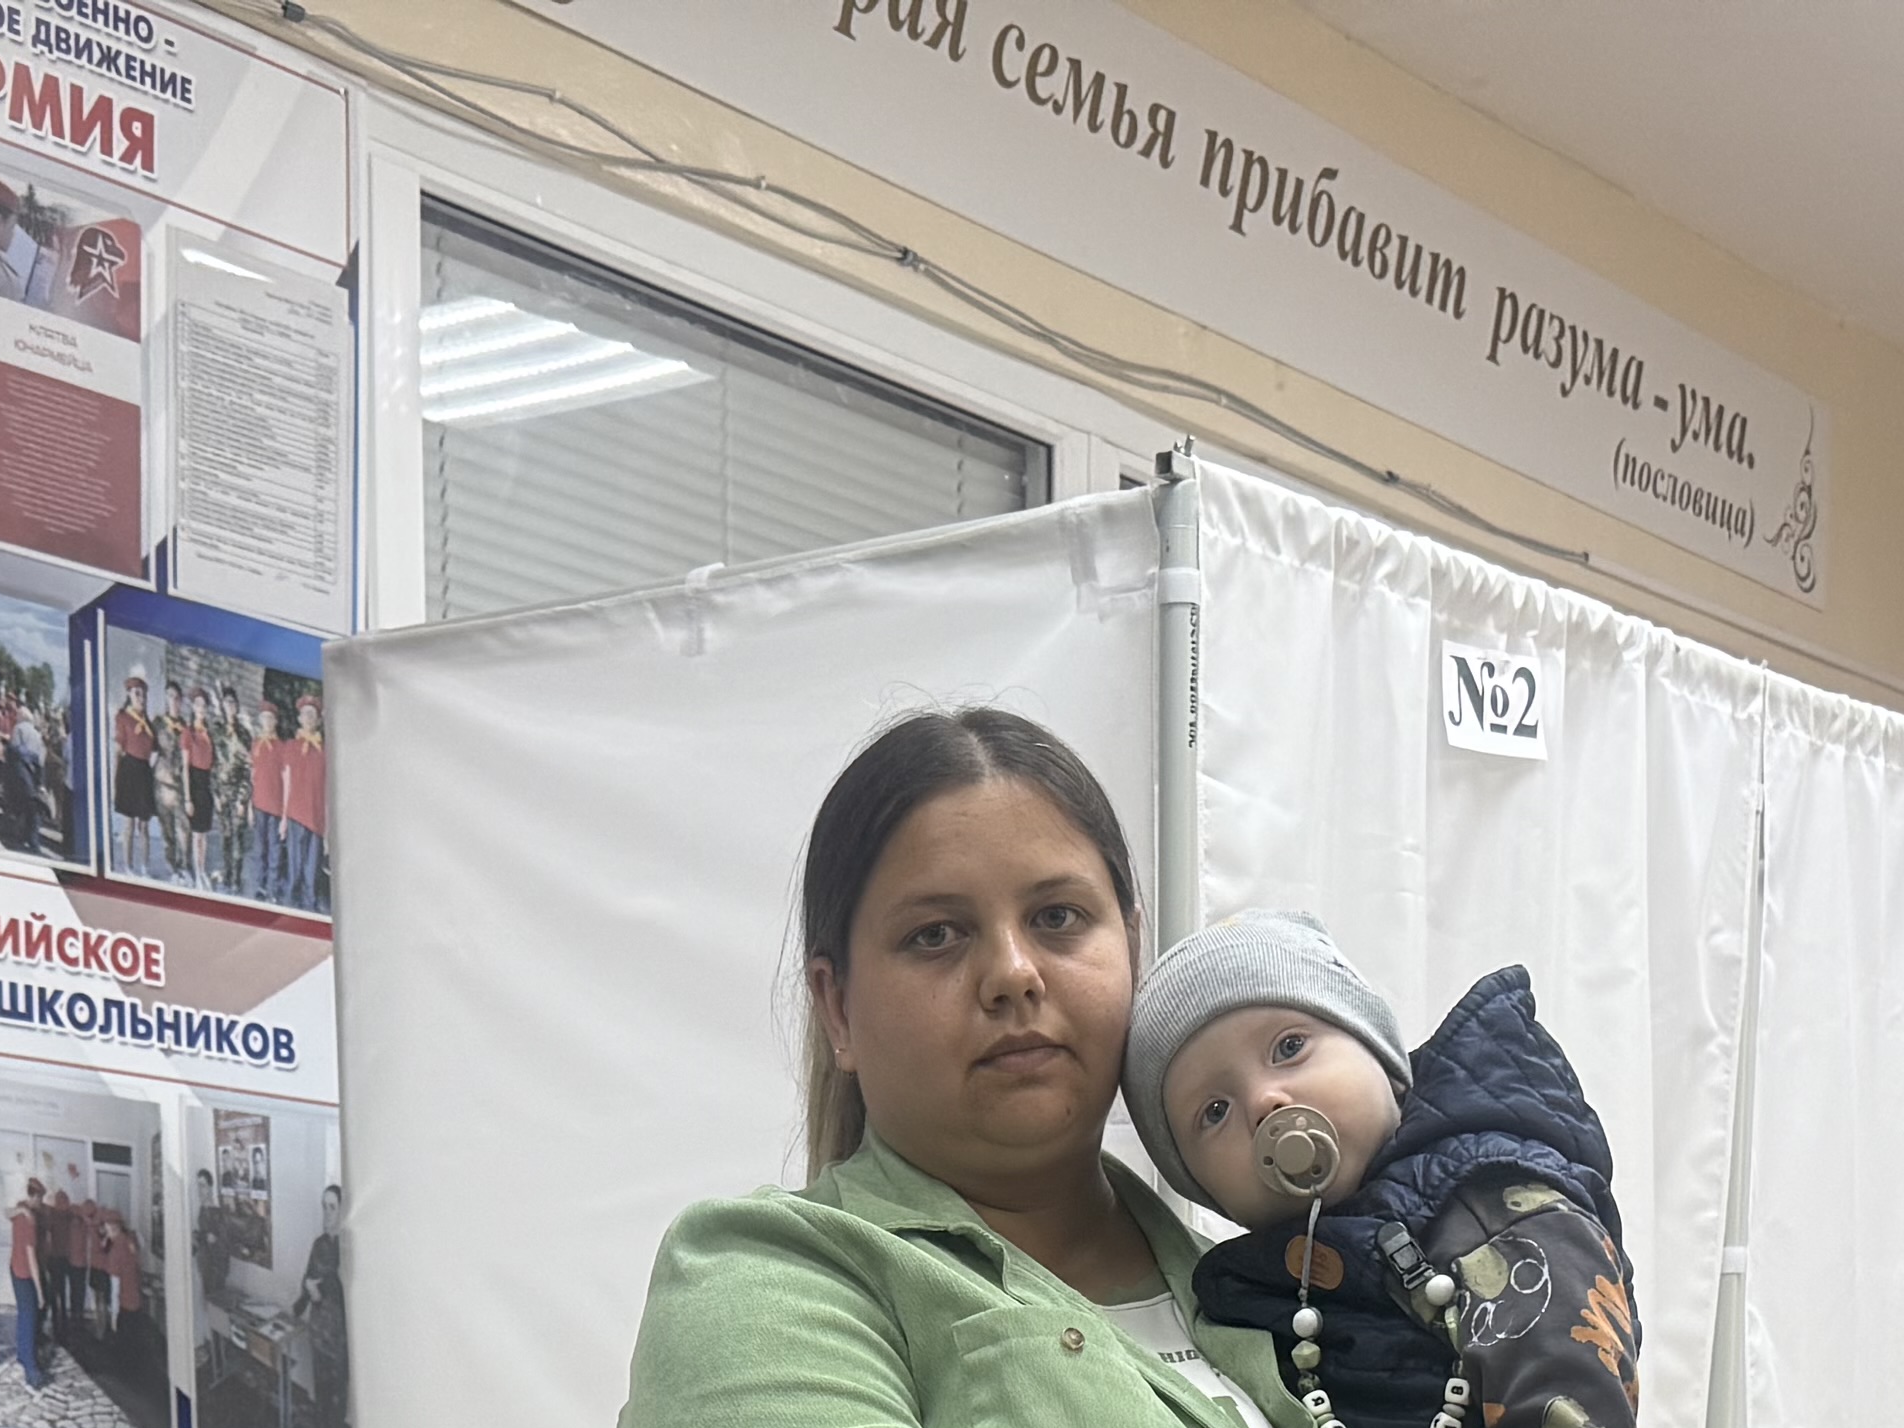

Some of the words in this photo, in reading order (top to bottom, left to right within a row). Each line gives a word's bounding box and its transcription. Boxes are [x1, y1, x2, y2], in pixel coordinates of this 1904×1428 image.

[32, 17, 193, 104] ДВИЖЕНИЕ
[36, 0, 154, 43] ОЕННО
[991, 24, 1177, 169] семья
[1199, 128, 1467, 320] прибавит
[1613, 437, 1756, 547] (пословица)
[1448, 655, 1539, 739] №2
